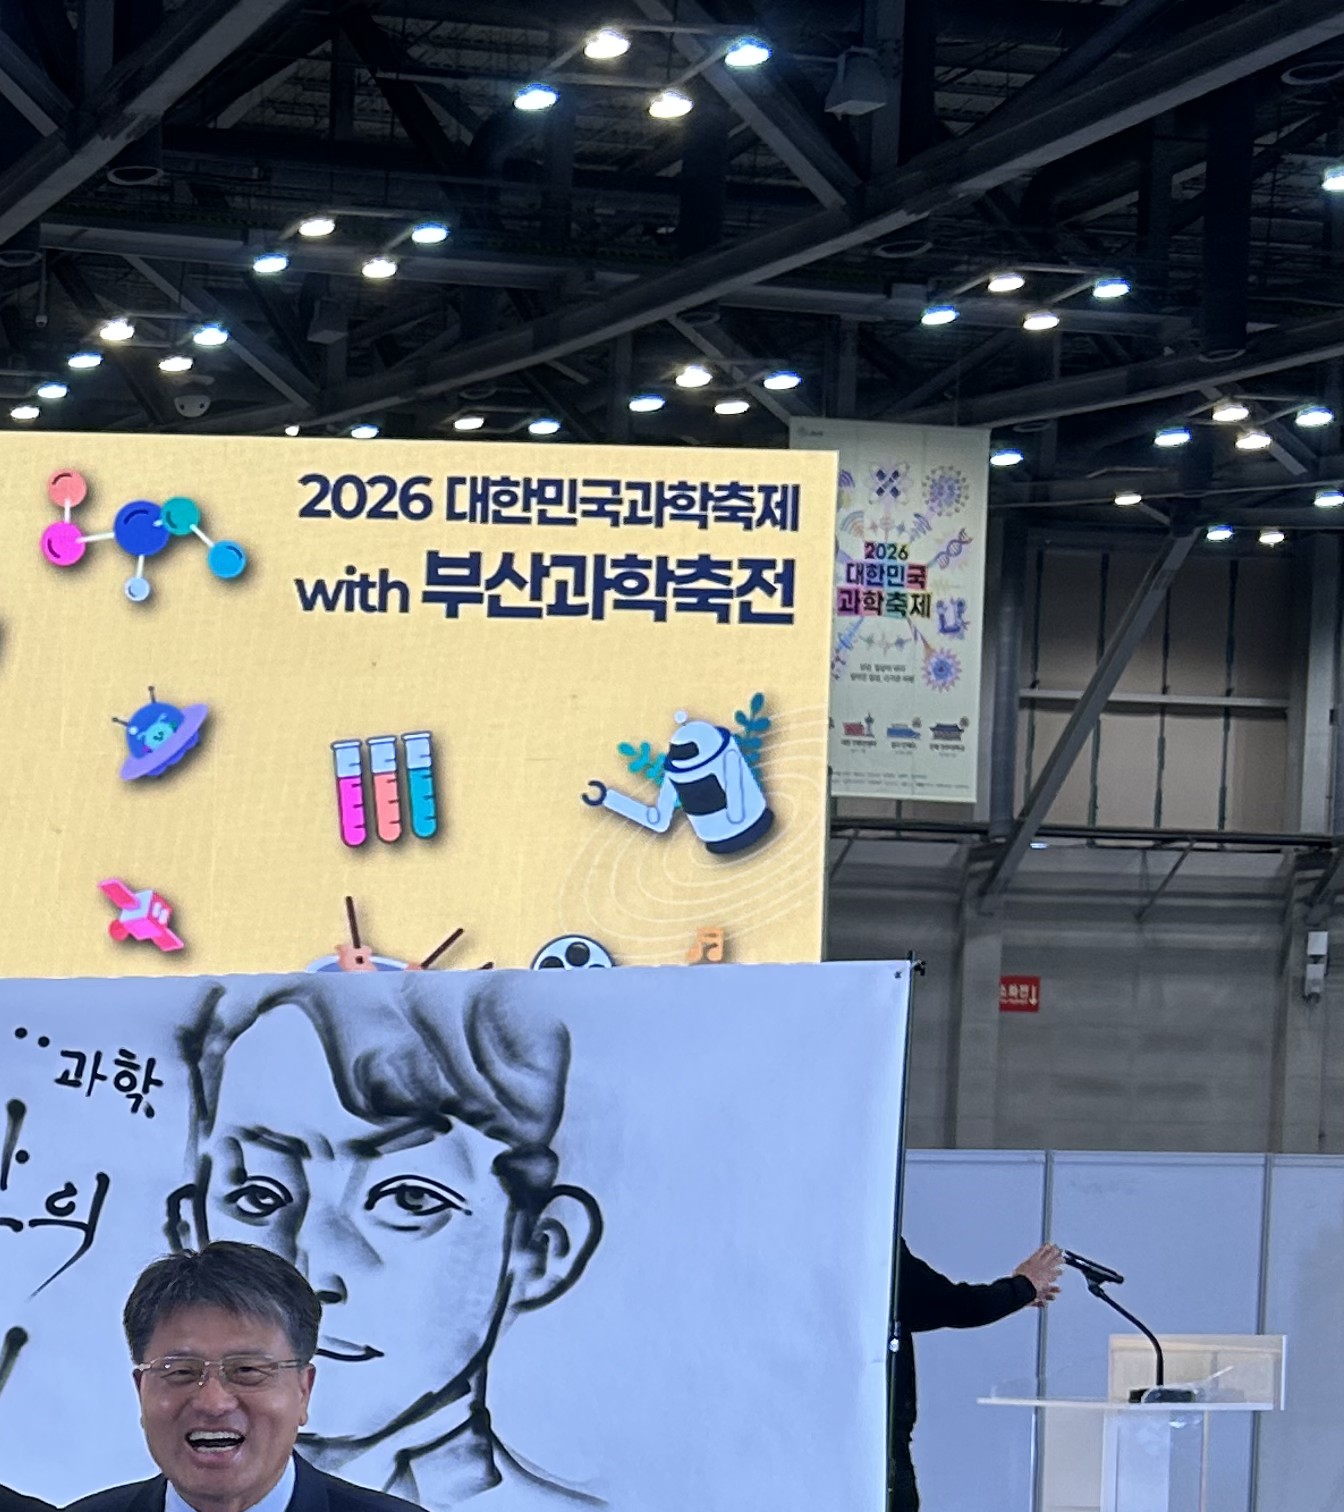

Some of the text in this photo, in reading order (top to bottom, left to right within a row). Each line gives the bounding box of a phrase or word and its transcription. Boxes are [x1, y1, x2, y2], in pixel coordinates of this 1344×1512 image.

[297, 473, 800, 532] 2026 대한민국과학축제
[864, 541, 909, 561] 2026
[294, 550, 796, 625] with 부산과학축전
[846, 562, 927, 590] 대한민국
[837, 588, 932, 619] 과학축제
[54, 1047, 165, 1119] 과학
